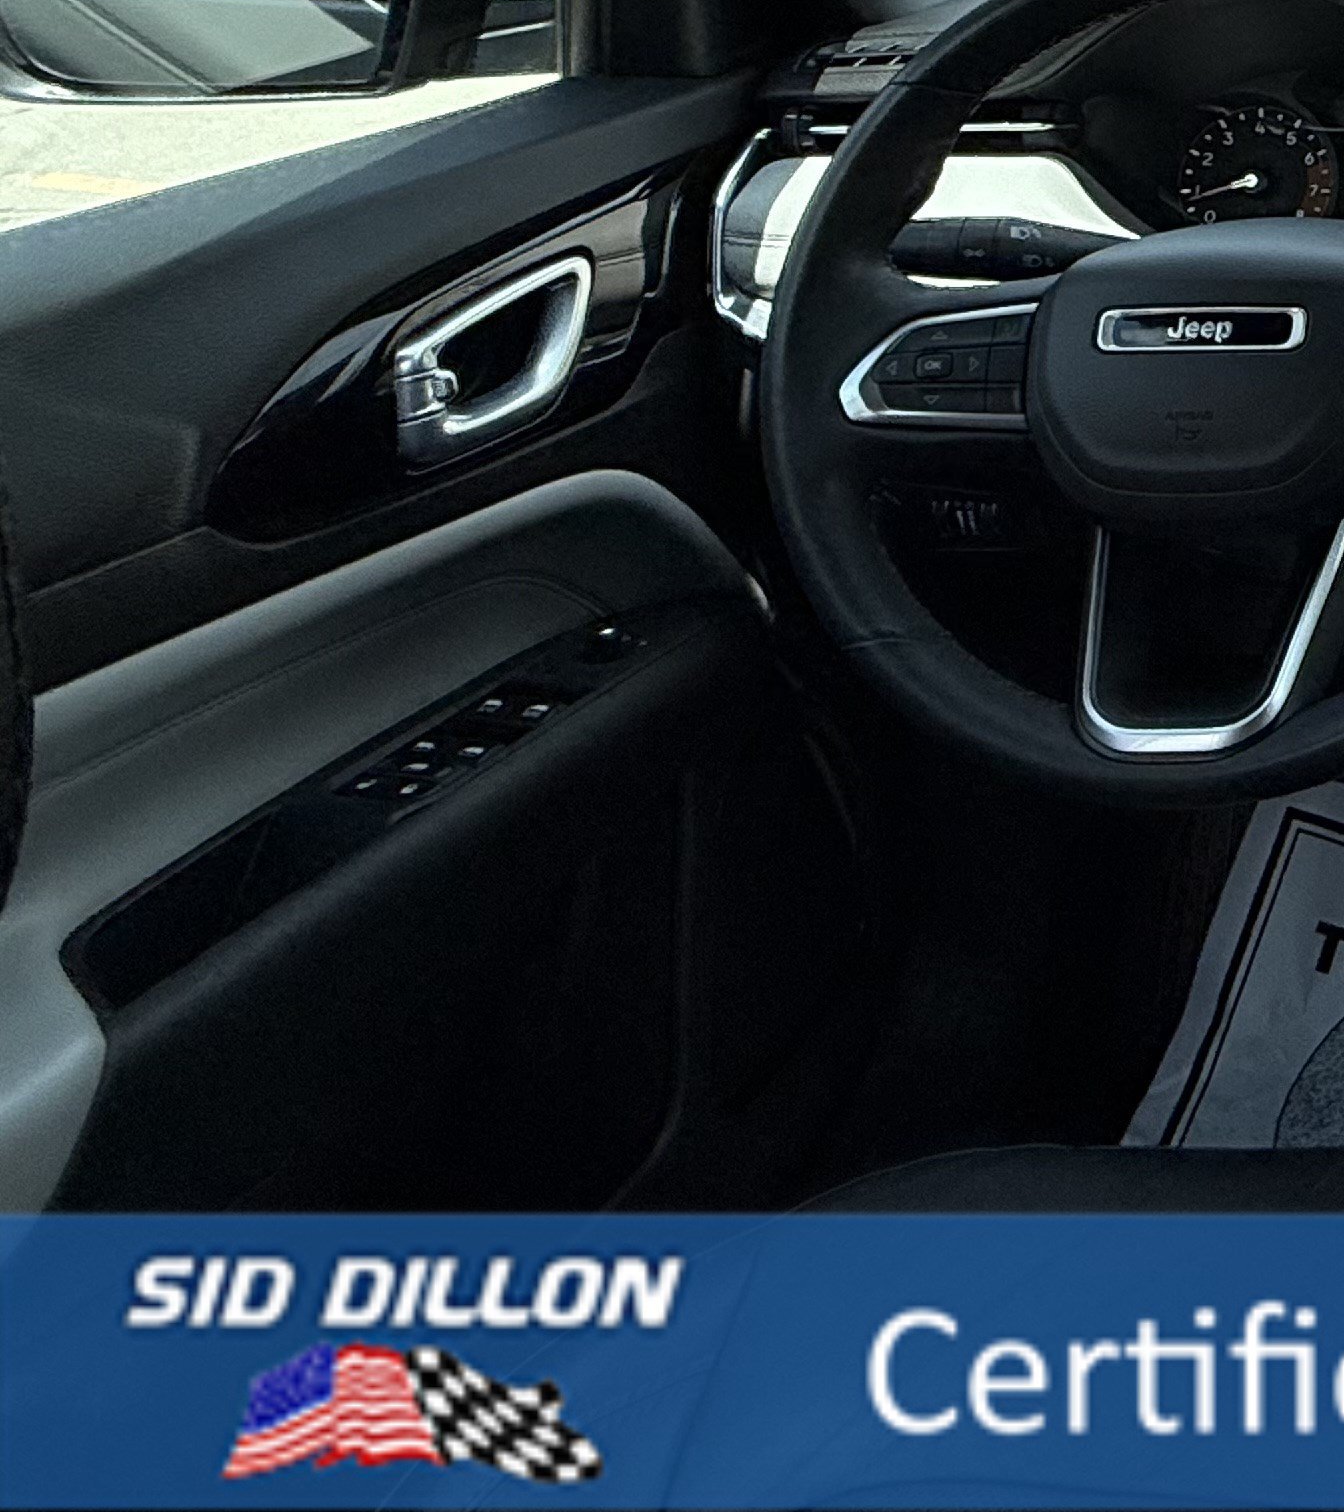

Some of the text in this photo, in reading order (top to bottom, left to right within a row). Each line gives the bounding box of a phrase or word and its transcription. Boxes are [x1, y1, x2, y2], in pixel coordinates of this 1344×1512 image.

[1222, 131, 1235, 146] 3
[1285, 130, 1298, 146] 5
[1201, 152, 1215, 167] 2
[1303, 152, 1315, 166] 6
[1167, 317, 1233, 343] Jeep
[924, 358, 943, 371] OK
